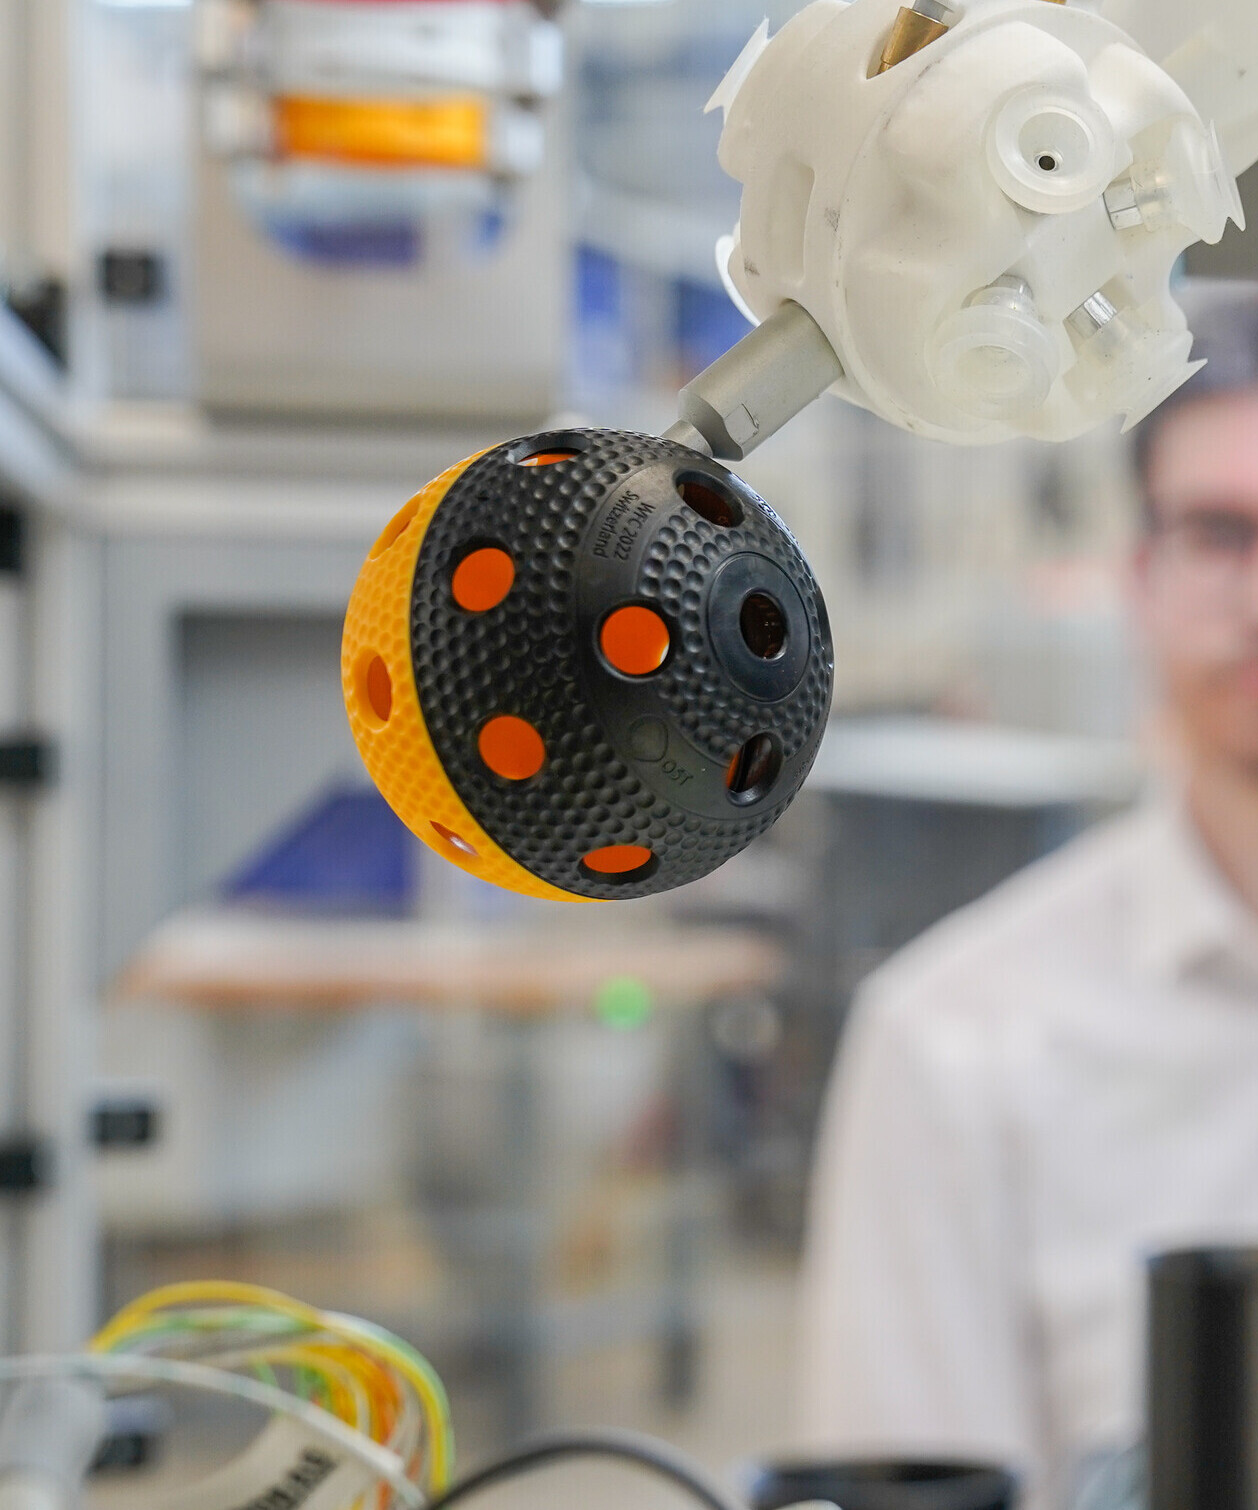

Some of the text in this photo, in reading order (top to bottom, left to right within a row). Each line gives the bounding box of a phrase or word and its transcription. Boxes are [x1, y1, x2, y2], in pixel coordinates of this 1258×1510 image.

[593, 490, 640, 559] Switzerland
[613, 502, 656, 561] WFC 2022
